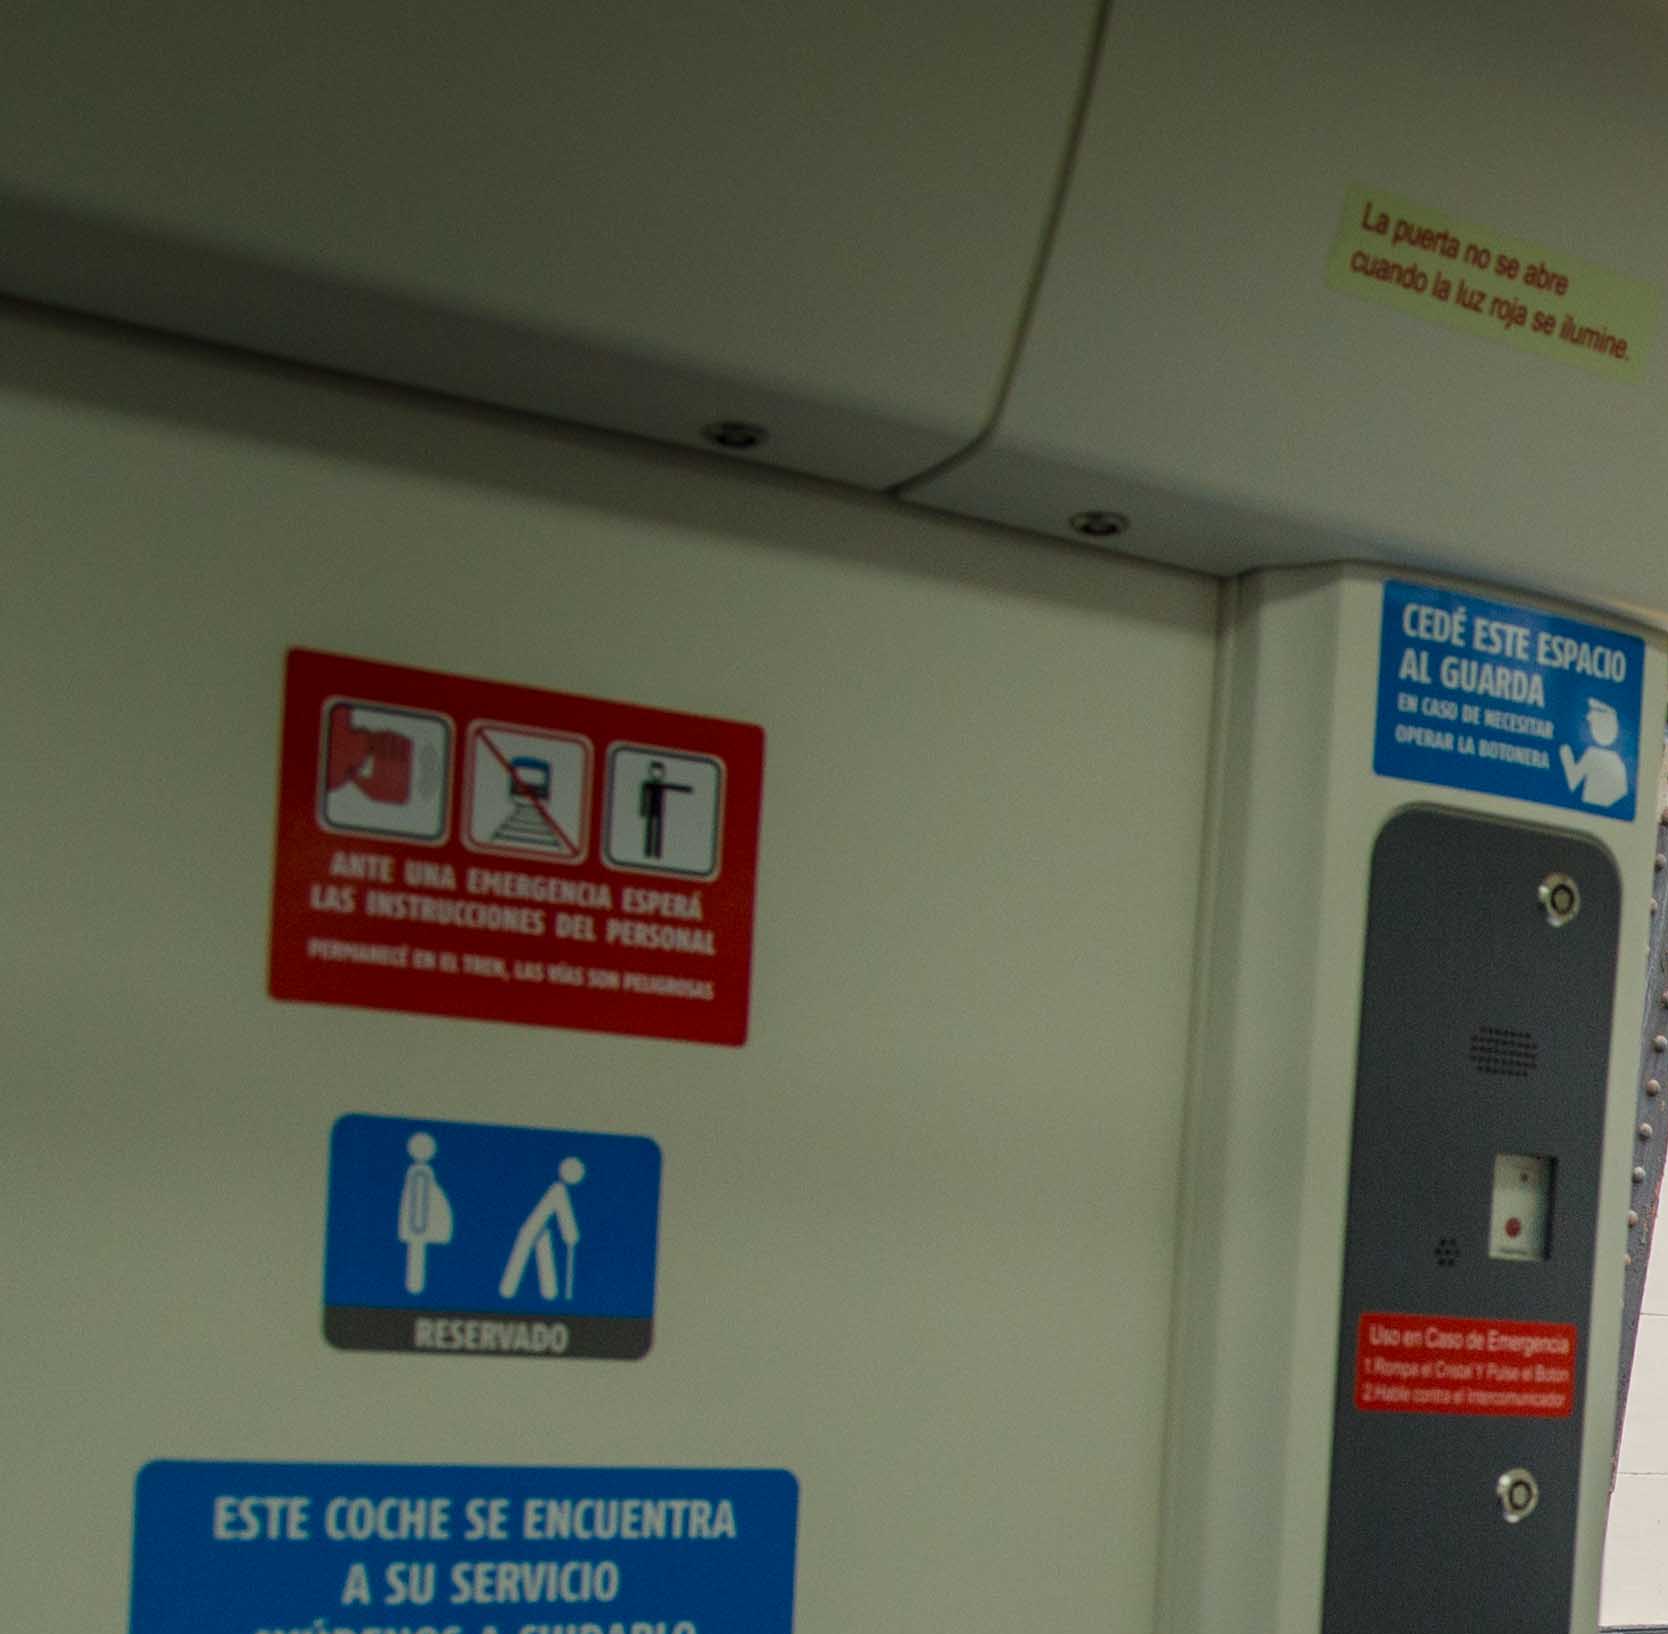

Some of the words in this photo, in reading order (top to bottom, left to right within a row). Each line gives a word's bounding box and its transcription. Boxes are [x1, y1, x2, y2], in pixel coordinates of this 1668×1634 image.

[1361, 201, 1390, 235] La
[1392, 217, 1461, 259] puerta
[1464, 241, 1491, 270] no
[1494, 253, 1521, 280] se
[1523, 261, 1569, 296] abre
[1350, 250, 1429, 294] cuando
[1431, 271, 1451, 301] la
[1455, 279, 1487, 313] luz
[1489, 296, 1528, 330] roja
[1530, 308, 1557, 335] se
[1559, 314, 1630, 361] ilumine.
[1402, 602, 1467, 648] CEDÉ
[1473, 617, 1531, 662] ESTE
[1536, 631, 1627, 683] ESPACIO
[1399, 647, 1431, 685] AL
[1440, 655, 1545, 708] GUARDA
[1397, 692, 1418, 713] EN
[1422, 696, 1458, 721] CASO
[1461, 703, 1481, 725] DE
[1484, 708, 1554, 739] NECESITAR
[1394, 723, 1454, 751] OPERAR
[1457, 734, 1475, 755] LA
[1478, 738, 1550, 769] BOTONERA
[330, 850, 394, 884] ANTE
[405, 859, 456, 892] UNA
[467, 867, 611, 911] EMERGENCIA
[621, 885, 704, 921] ESPERÁ
[310, 884, 356, 914] LAS
[366, 890, 545, 937] INSTRUCCIONES
[555, 915, 597, 943] DEL
[605, 920, 717, 957] PERSONAL
[413, 950, 438, 971] EN
[440, 952, 460, 974] EL
[514, 960, 546, 983] LAS
[587, 967, 620, 991] SON
[623, 972, 715, 1000] PELIGROSAS
[413, 1318, 570, 1354] RESERVADO
[1369, 1323, 1400, 1346] Uso
[1424, 1326, 1464, 1350] Caso
[1465, 1330, 1485, 1351] de
[1487, 1329, 1570, 1357] Emergencia
[212, 1496, 310, 1540] ESTE
[325, 1496, 450, 1541] COCHE
[464, 1498, 509, 1540] SE
[523, 1499, 737, 1540] ENCUENTRA
[341, 1563, 371, 1605] A
[384, 1562, 435, 1605] SU
[450, 1560, 620, 1605] SERVICIO
